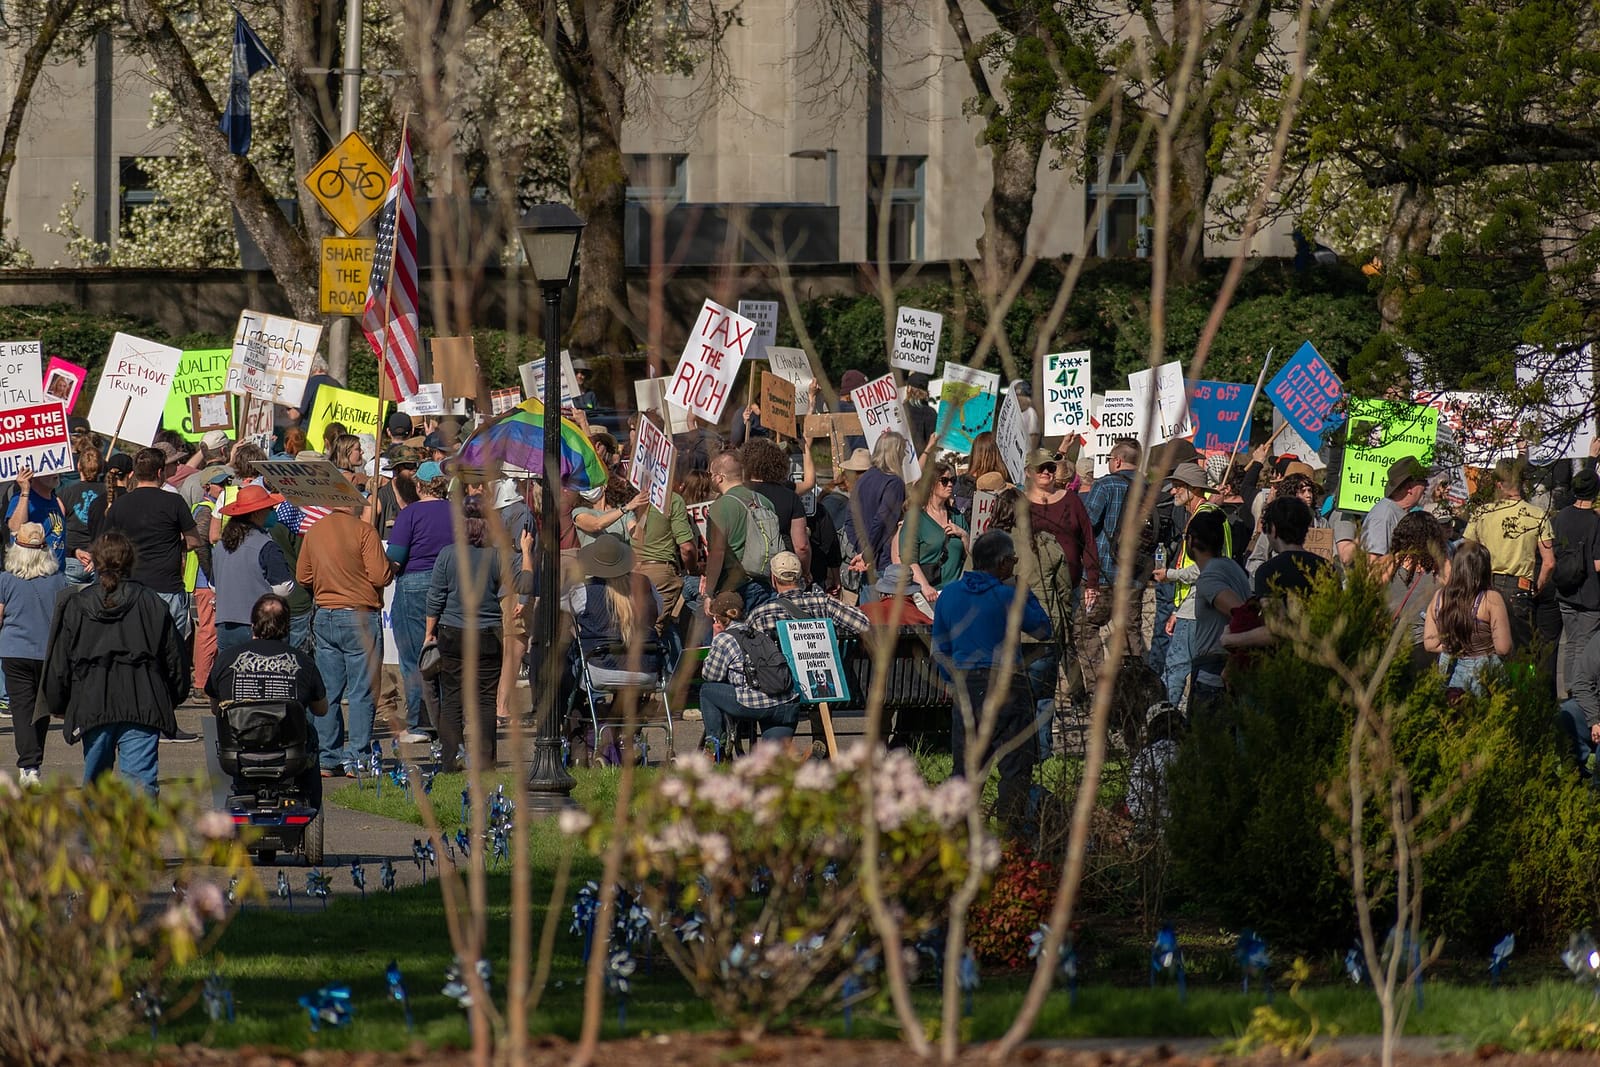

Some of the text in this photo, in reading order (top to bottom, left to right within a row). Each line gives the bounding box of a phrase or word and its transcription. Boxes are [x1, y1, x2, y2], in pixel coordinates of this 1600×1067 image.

[326, 247, 372, 262] SHARE
[336, 269, 362, 283] THE
[329, 291, 367, 305] ROAD
[701, 306, 753, 356] TAX
[919, 316, 932, 329] the
[236, 316, 303, 358] Impeach
[900, 337, 935, 354] do NOT
[10, 344, 39, 356] HORSE
[700, 344, 725, 371] THE
[7, 363, 24, 374] OF
[175, 354, 231, 378] QUALITY
[267, 352, 305, 371] EMOVE
[118, 360, 170, 386] REMOVE
[1055, 368, 1079, 387] 47
[1307, 358, 1340, 398] END
[106, 374, 148, 397] TRUMP
[172, 375, 224, 395] HURTS
[672, 361, 728, 415] RICH
[856, 375, 898, 409] HANDS
[1048, 385, 1085, 402] DUMP
[3, 389, 40, 404] ITAL
[321, 400, 380, 426] NEVERTHELE
[866, 401, 890, 426] OFF
[1060, 401, 1083, 413] THE
[1275, 380, 1323, 432] UNITED
[31, 410, 62, 426] THE
[1054, 409, 1090, 426] GOP!
[1102, 411, 1135, 428] RESIS
[0, 424, 65, 446] ONSENSE
[1160, 417, 1189, 439] LEON
[639, 419, 671, 469] USAID
[636, 445, 667, 486] SAVES
[1354, 449, 1396, 467] change
[262, 463, 330, 478] HANDS
[1354, 493, 1381, 504] neve
[788, 621, 826, 631] No More Tax
[793, 632, 826, 641] Giveaways
[797, 651, 831, 660] Billionaire
[806, 661, 826, 669] Jokers
